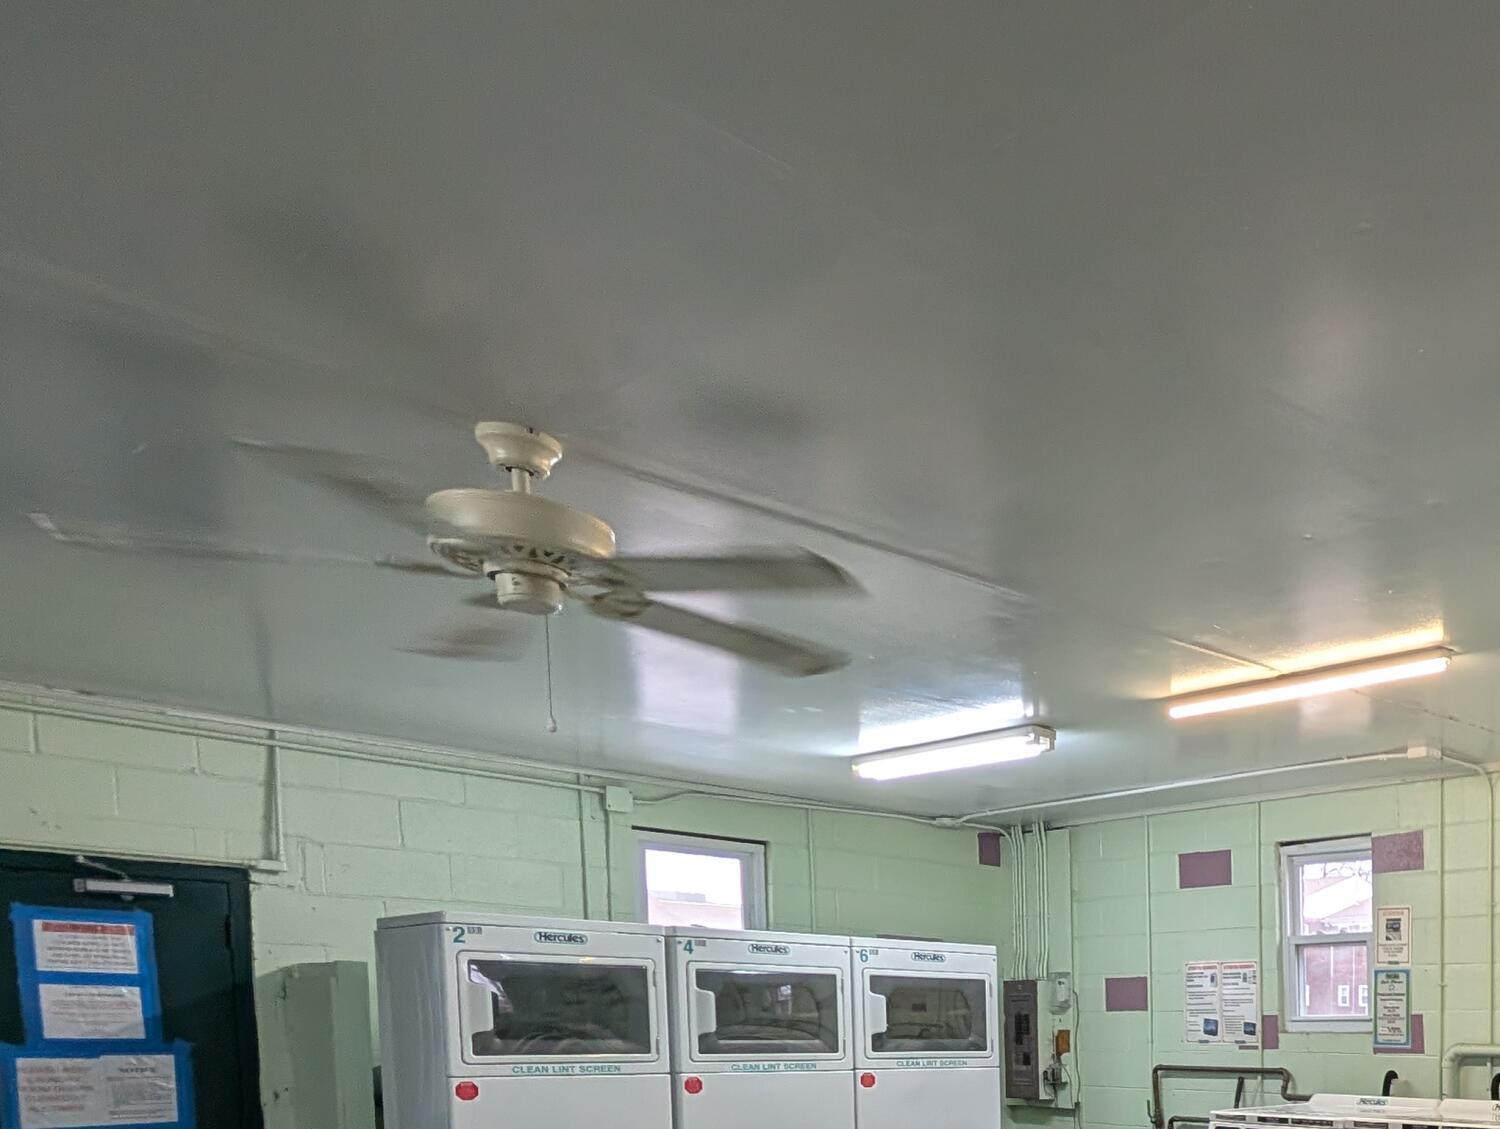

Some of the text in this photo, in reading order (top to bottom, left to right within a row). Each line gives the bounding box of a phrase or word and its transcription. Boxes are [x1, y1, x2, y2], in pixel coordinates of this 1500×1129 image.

[453, 926, 466, 944] 2
[538, 931, 585, 944] Hercules
[683, 940, 694, 955] 4
[751, 943, 788, 954] Hercules
[859, 949, 869, 963] 6
[913, 951, 944, 961] Hercules
[511, 1065, 621, 1074] CLEAN LINT SCREEN
[731, 1063, 760, 1071] CLEAN
